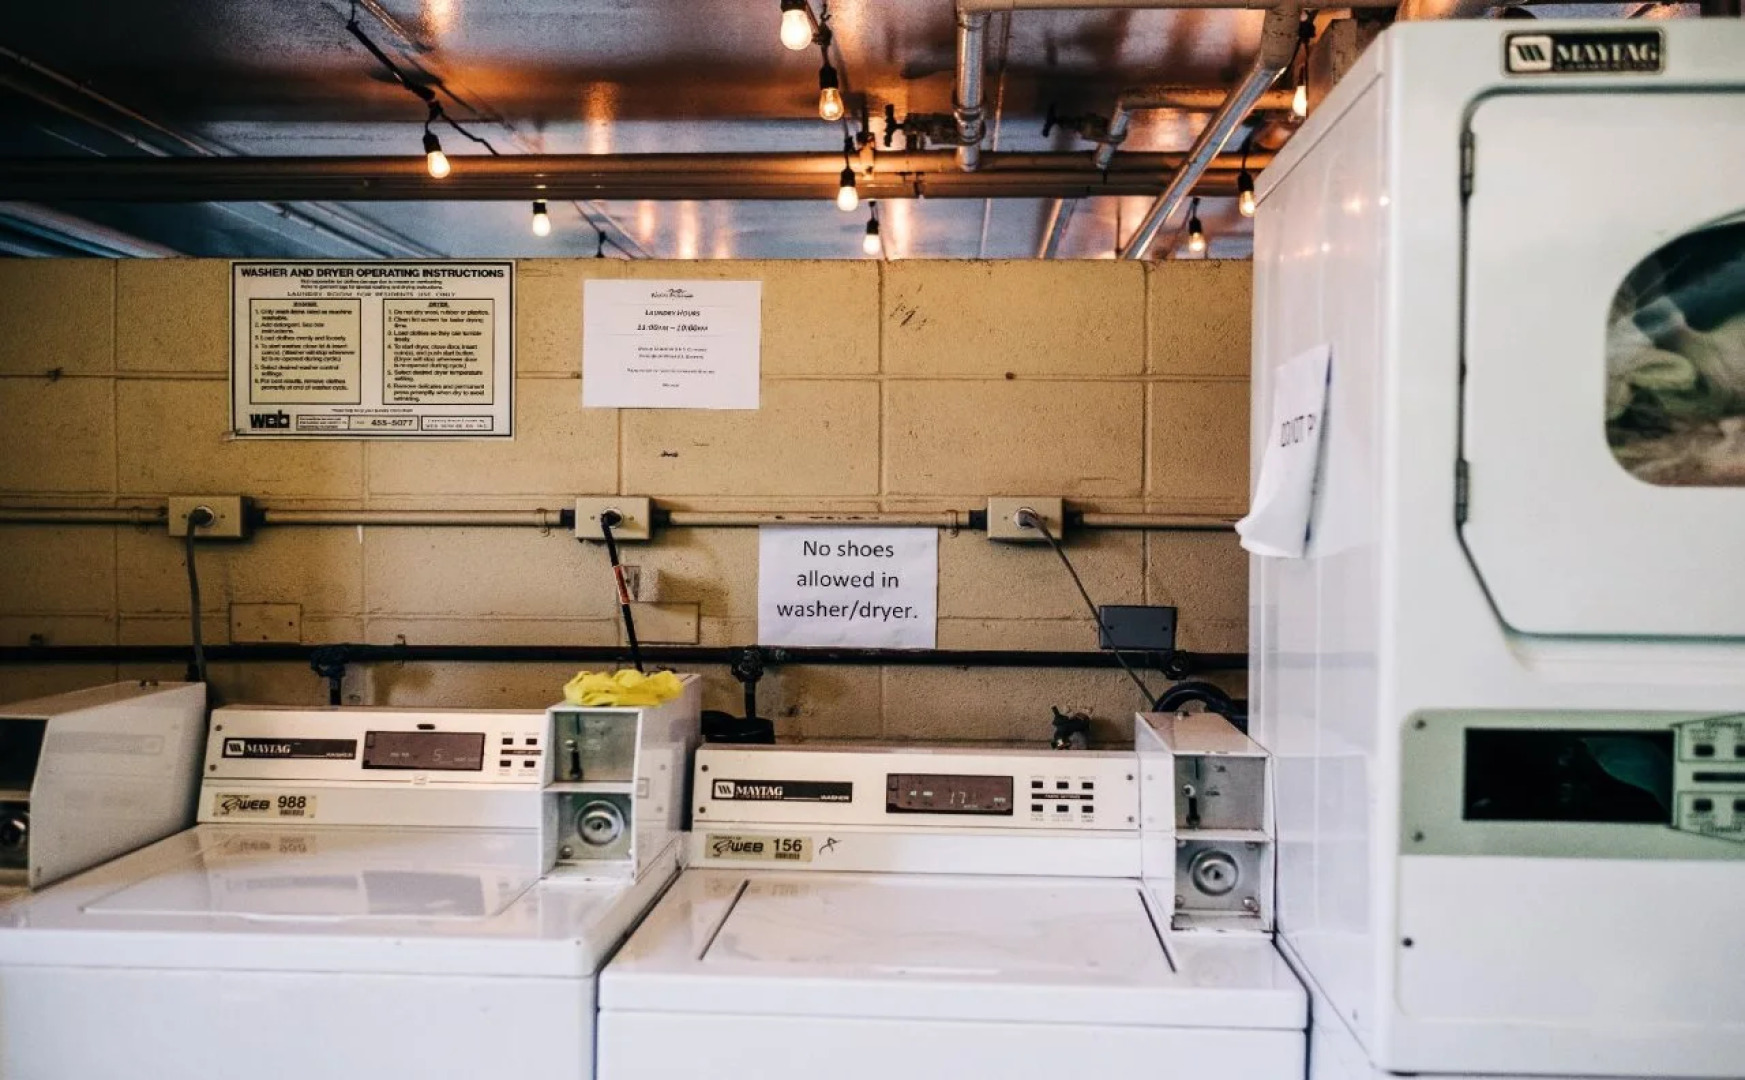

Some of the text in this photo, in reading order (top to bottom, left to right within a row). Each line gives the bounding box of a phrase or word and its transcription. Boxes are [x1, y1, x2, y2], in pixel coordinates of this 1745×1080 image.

[1557, 44, 1658, 62] MAYTAG
[241, 268, 504, 277] WASHER AND DRYER OPERATING INSTRUCTIONS
[803, 540, 894, 557] No shoes
[797, 570, 899, 588] allowed in
[777, 599, 918, 622] washer/dryer.
[247, 743, 291, 754] MAYTAG
[736, 787, 783, 796] MAYTAG
[239, 800, 270, 810] WEB
[277, 796, 306, 808] 988
[731, 842, 764, 852] WEB
[774, 839, 802, 852] 156
